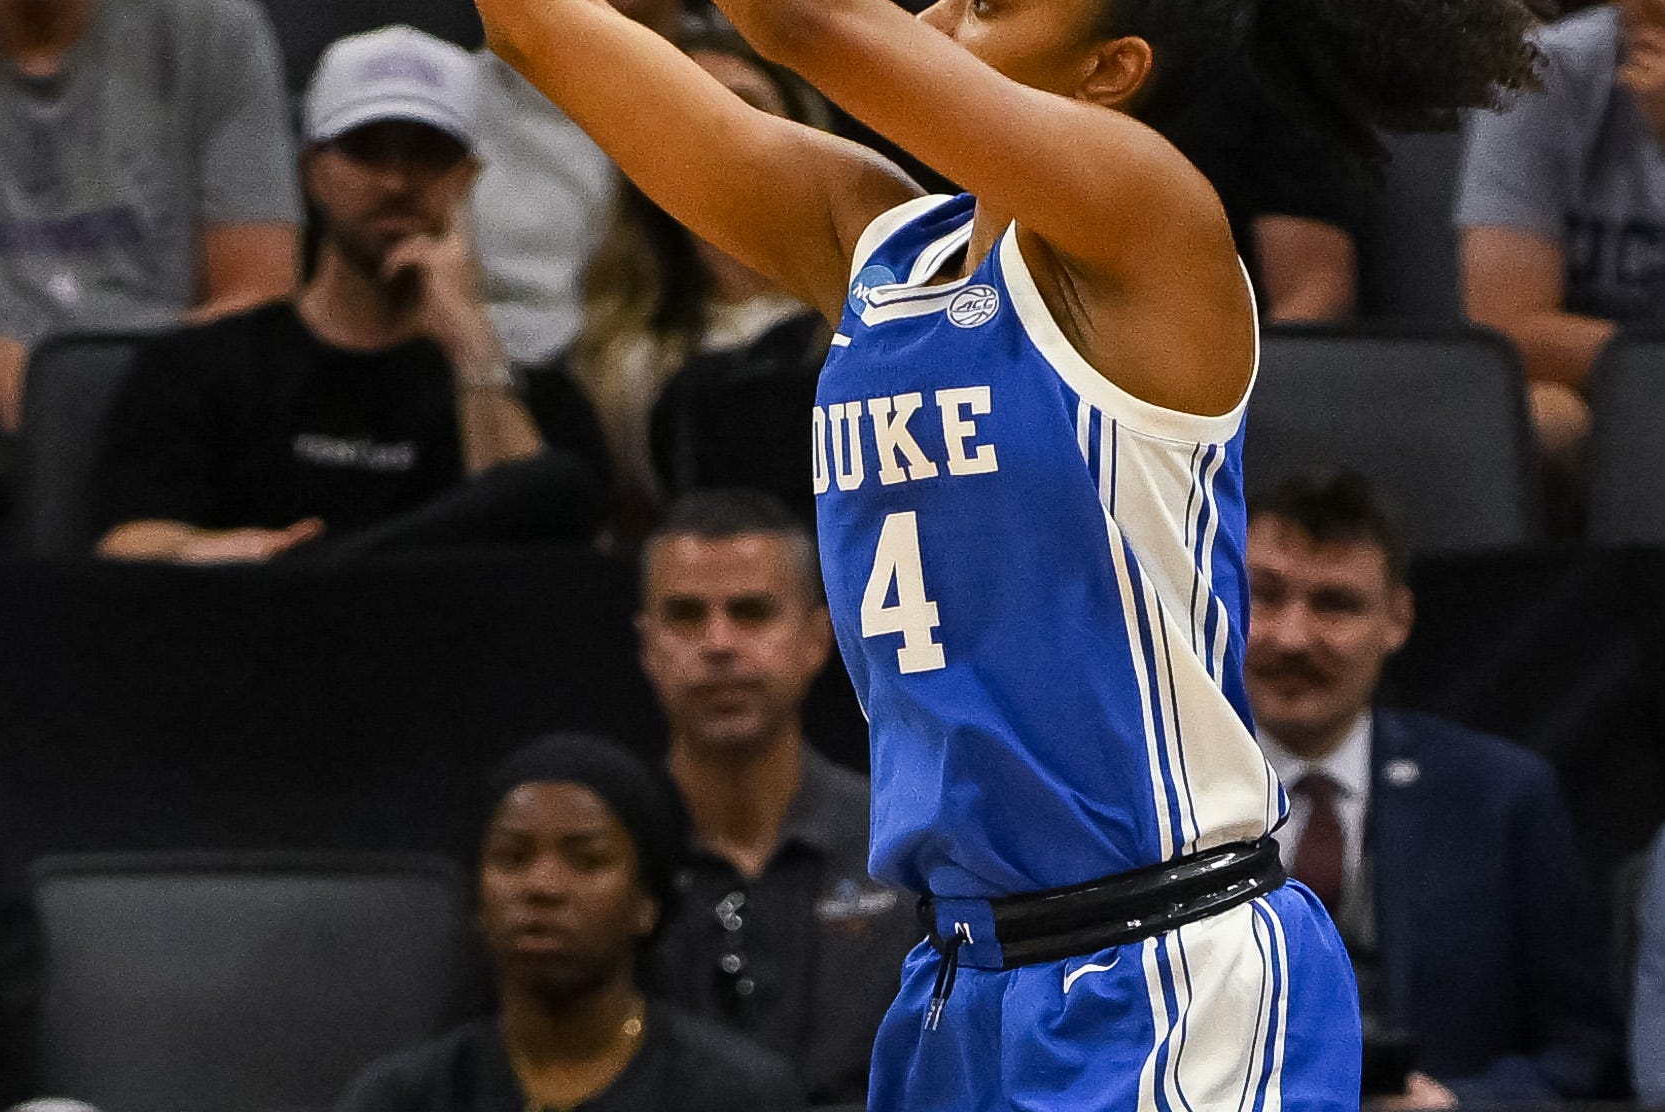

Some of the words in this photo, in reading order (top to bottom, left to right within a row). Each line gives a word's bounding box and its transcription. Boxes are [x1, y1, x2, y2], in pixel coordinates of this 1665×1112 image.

[955, 295, 995, 312] ACC
[812, 385, 999, 495] DUKE
[860, 510, 947, 675] 4
